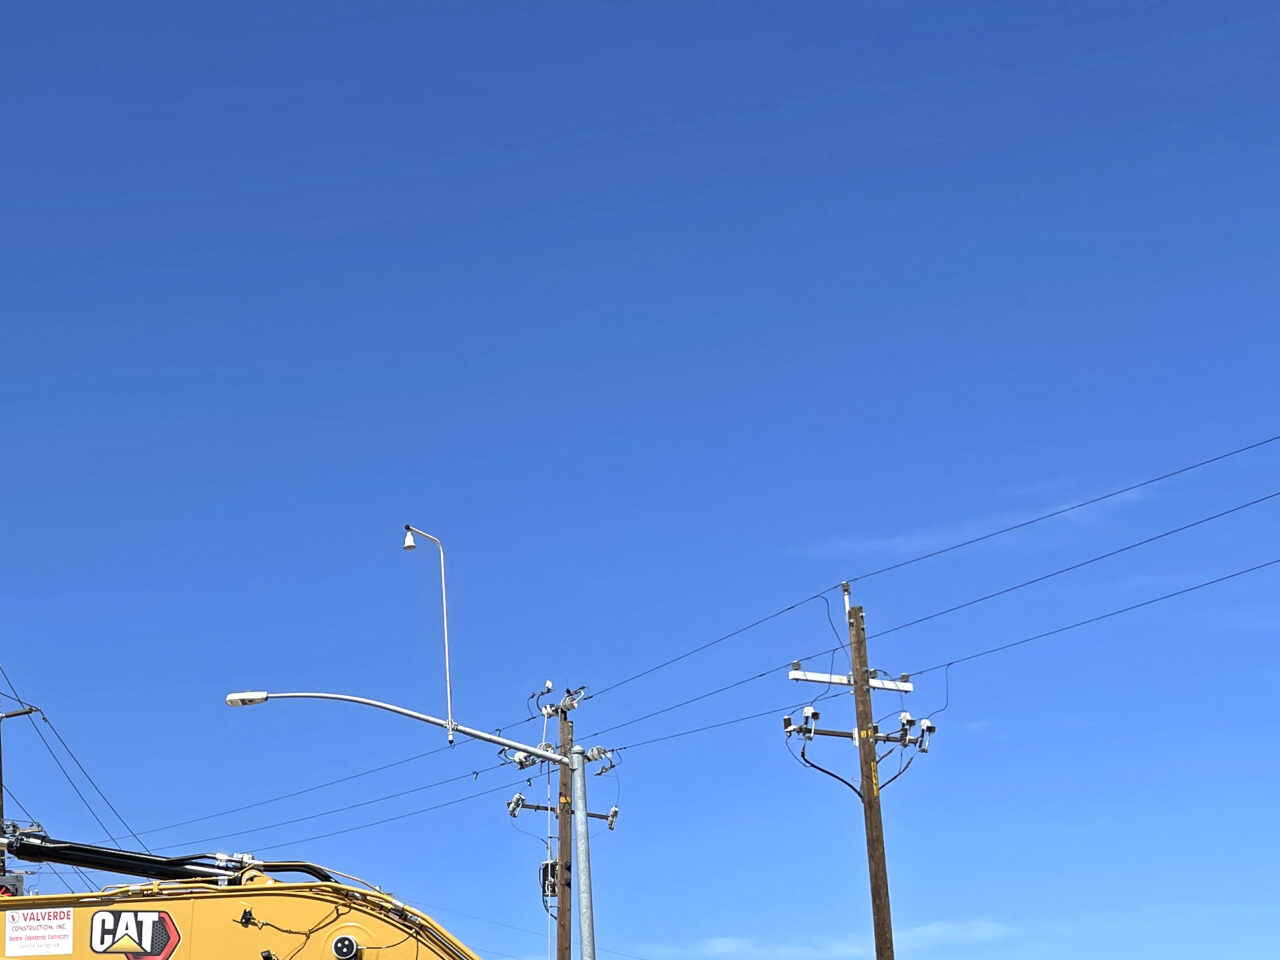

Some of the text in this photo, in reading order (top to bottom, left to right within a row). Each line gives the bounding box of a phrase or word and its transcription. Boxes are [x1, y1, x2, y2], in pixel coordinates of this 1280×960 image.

[22, 910, 71, 922] VALVERDE
[11, 924, 53, 932] CONSTRUCTION
[91, 911, 159, 953] CAT
